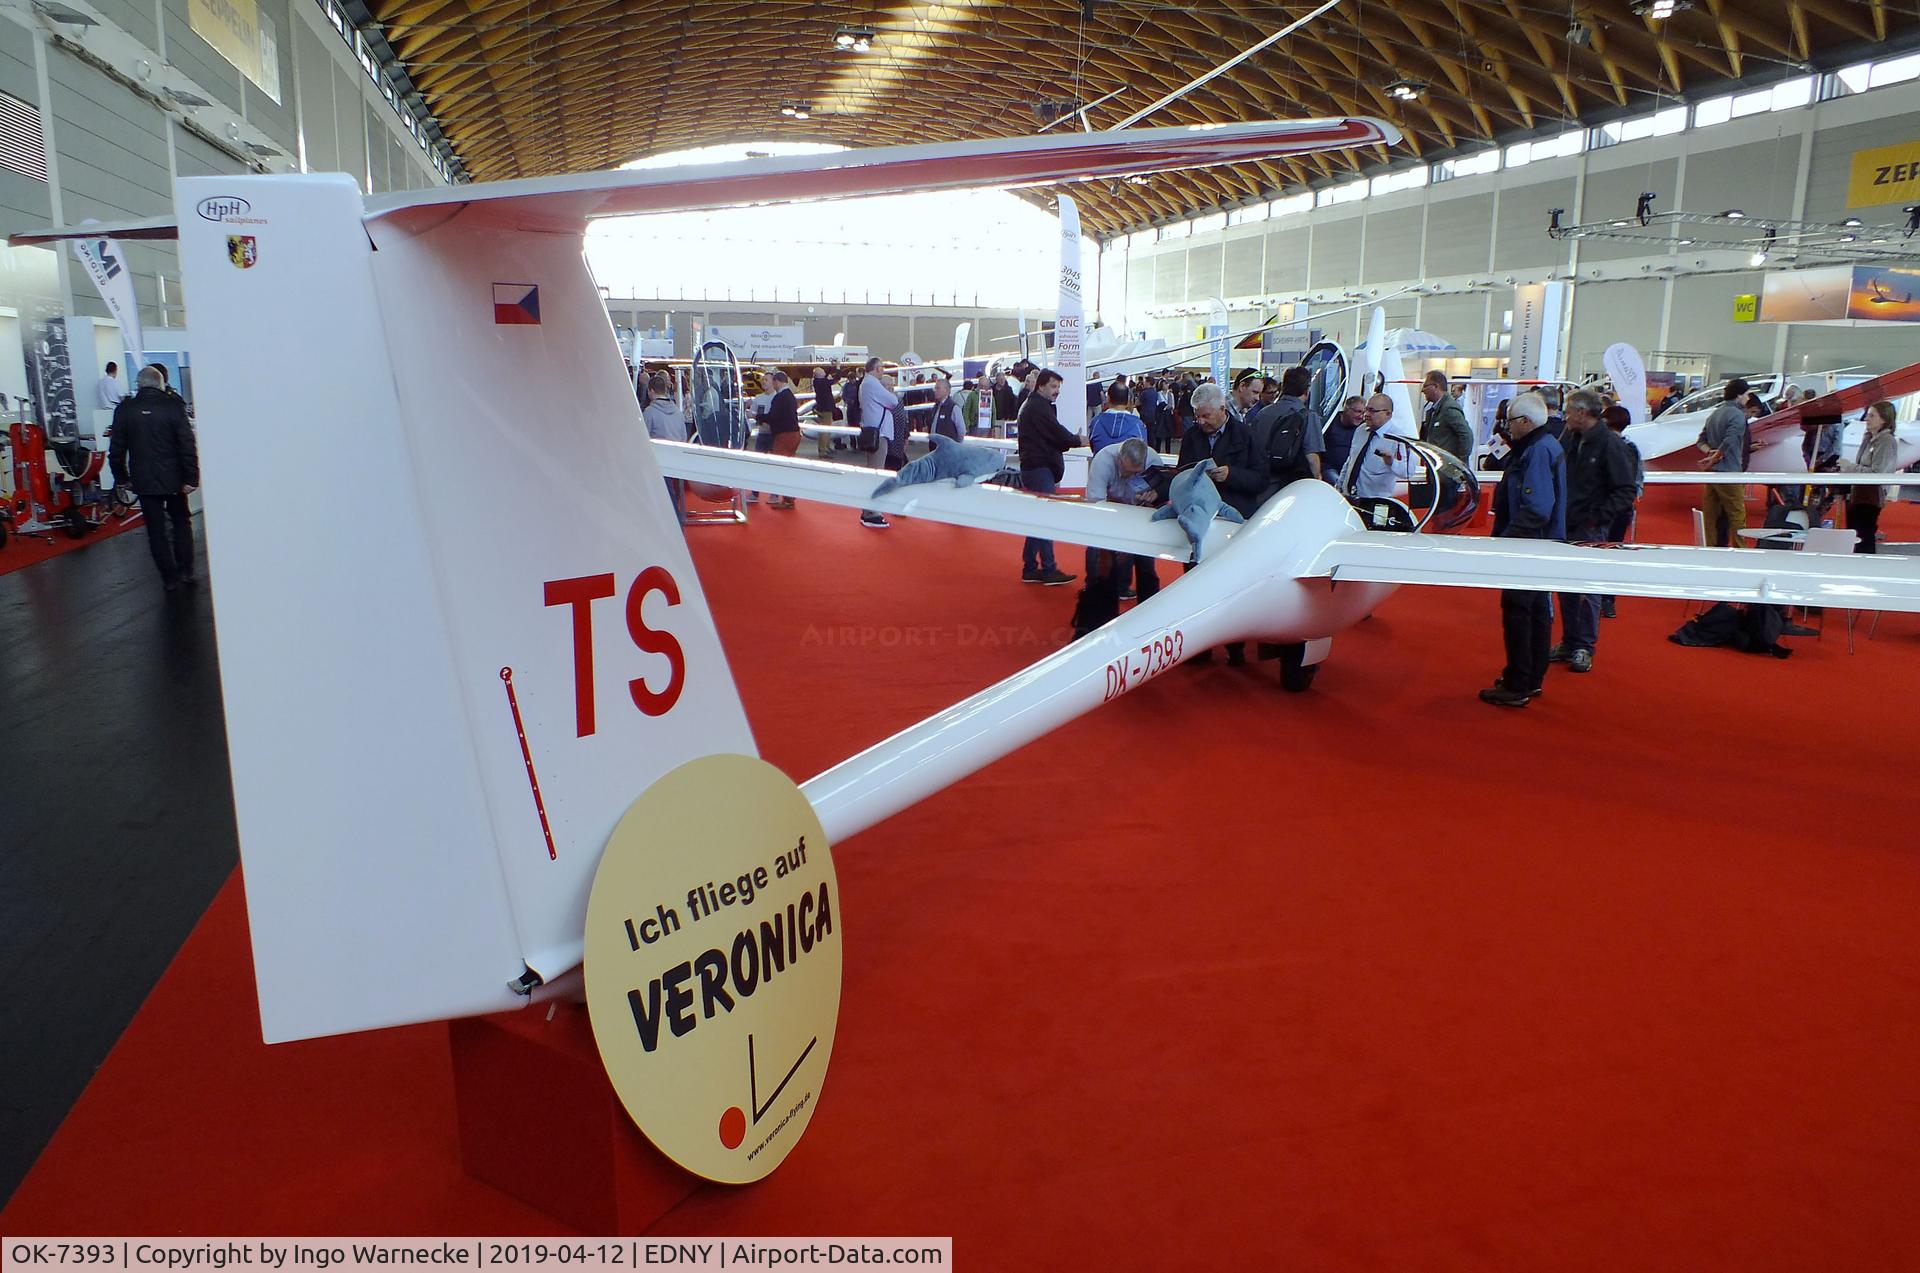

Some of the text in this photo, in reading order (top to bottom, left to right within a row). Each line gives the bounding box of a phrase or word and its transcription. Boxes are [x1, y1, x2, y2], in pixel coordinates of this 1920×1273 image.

[206, 201, 241, 221] HpH
[1061, 265, 1081, 280] 304S
[1060, 276, 1081, 292] 20m
[1736, 302, 1754, 313] WC
[1060, 319, 1079, 328] CNC
[1059, 342, 1080, 351] Form
[544, 565, 686, 738] TS
[1103, 630, 1184, 702] OK-7393
[624, 836, 807, 952] Ich fliege auf
[627, 882, 833, 1053] VERONICA
[747, 1091, 811, 1162] www.veronica-flying.de
